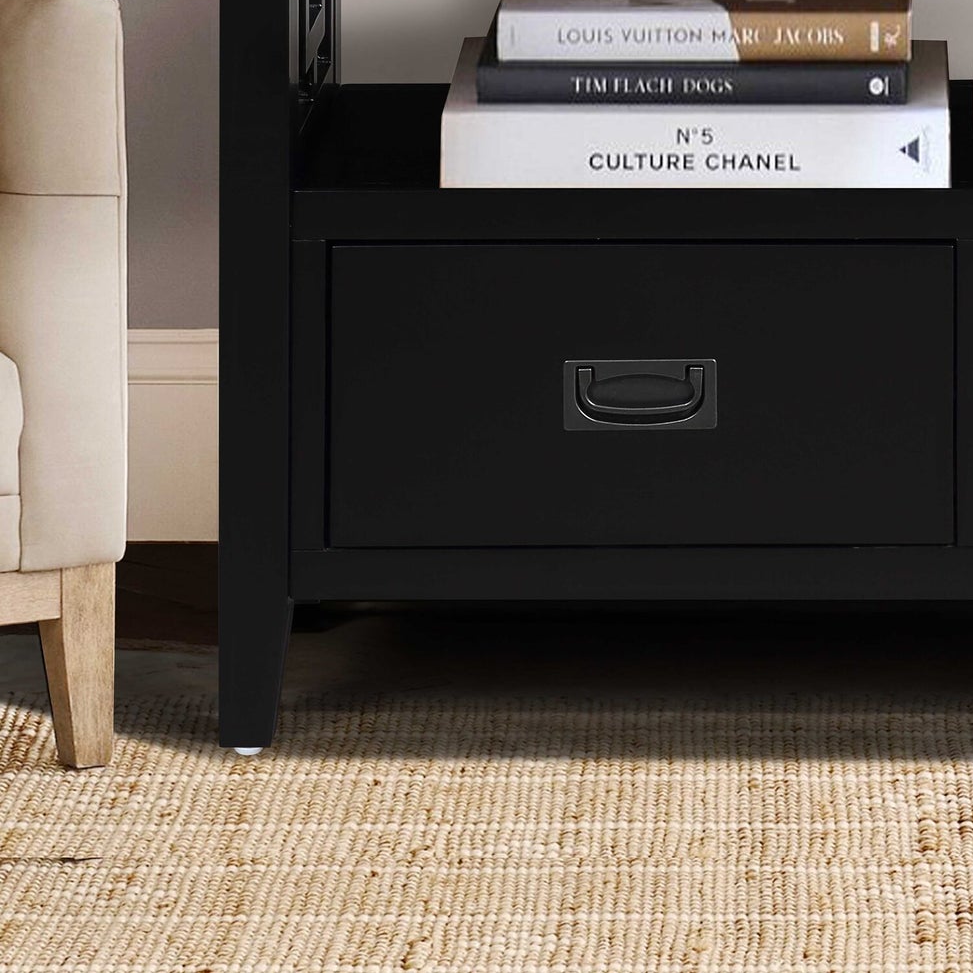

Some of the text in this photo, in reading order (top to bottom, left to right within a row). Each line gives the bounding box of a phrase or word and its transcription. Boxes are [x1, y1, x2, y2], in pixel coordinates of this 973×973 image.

[557, 28, 845, 45] LOUIS VUITTON MARC JACOBS
[570, 77, 734, 94] TIM FLACH DOGS
[588, 153, 801, 171] CULTURE CHANEL
